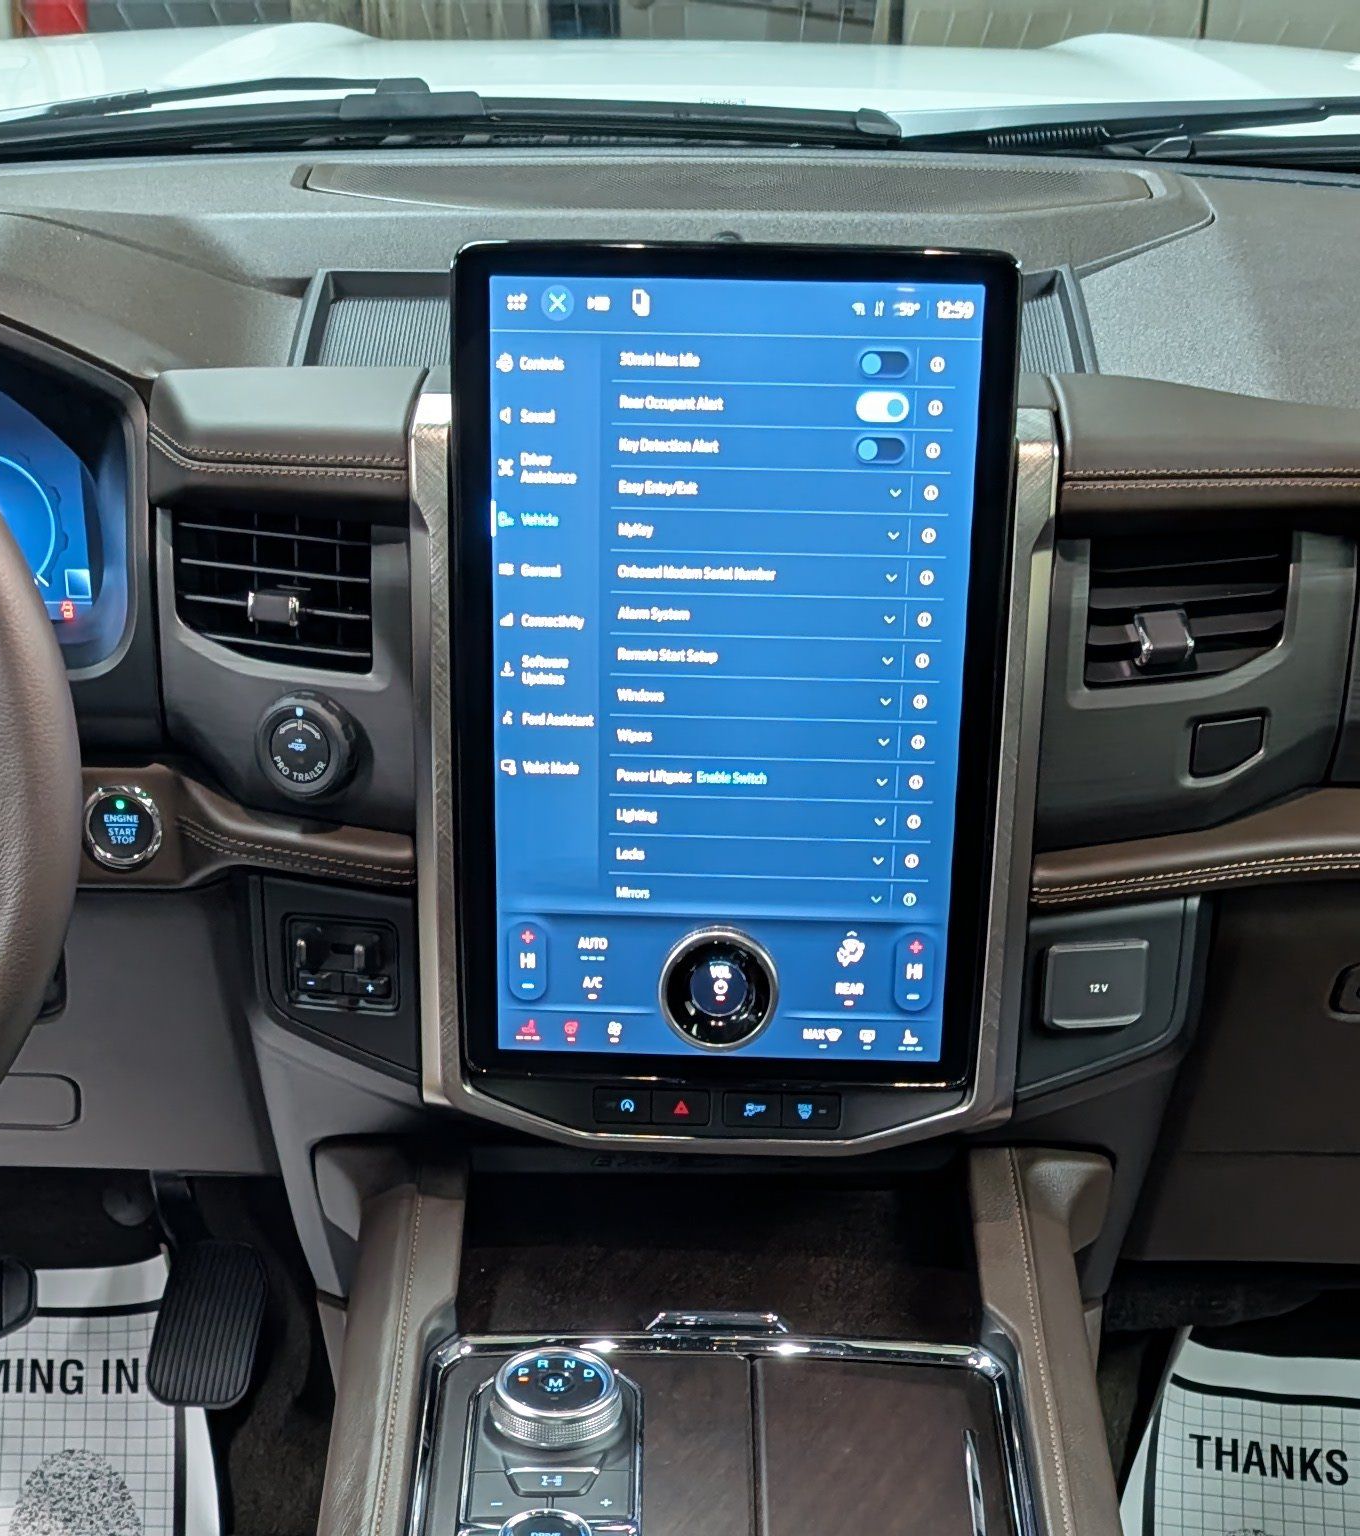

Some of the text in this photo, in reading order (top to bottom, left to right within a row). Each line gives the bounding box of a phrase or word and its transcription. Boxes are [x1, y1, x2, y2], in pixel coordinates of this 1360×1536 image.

[936, 300, 975, 319] 12:59
[519, 355, 565, 371] Controls
[655, 353, 679, 367] Max
[619, 394, 724, 412] Rear Occupant Alert
[520, 408, 556, 424] Sound
[618, 437, 720, 454] Key Detection Alert
[520, 452, 552, 467] Driver
[520, 469, 577, 485] Assistance
[618, 479, 699, 496] Easy Entry/Exit
[520, 511, 559, 527] Vehicle
[618, 522, 654, 538] MyKey
[520, 563, 561, 579] General
[617, 564, 777, 582] Onboard Modem Serial Number
[521, 613, 585, 630] Connectivity
[617, 606, 691, 622] Alarm System
[521, 654, 569, 669] Software
[617, 647, 719, 664] Remote Start Setup
[521, 672, 565, 687] Updates
[617, 688, 665, 703] Windows
[522, 712, 595, 728] Ford Assistant
[616, 729, 653, 744] Wipers
[273, 755, 327, 782] PRO TRAILER
[522, 760, 580, 776] Valet Mode
[616, 768, 649, 783] Power
[696, 769, 731, 785] Enable
[732, 770, 767, 785] Switch
[103, 814, 140, 824] ENGINE
[616, 808, 658, 824] Lighting
[108, 827, 137, 837] START
[110, 835, 135, 845] STOP
[615, 847, 645, 861] Locks
[615, 886, 650, 900] Mirrors
[577, 937, 608, 950] AUTO
[519, 952, 536, 969] HI
[709, 965, 732, 980] VOL
[906, 963, 923, 980] HI
[582, 976, 603, 989] A/C
[835, 982, 865, 995] REAR
[803, 1028, 826, 1040] MAX
[101, 1357, 140, 1395] IN
[1188, 1433, 1349, 1487] THANKS
